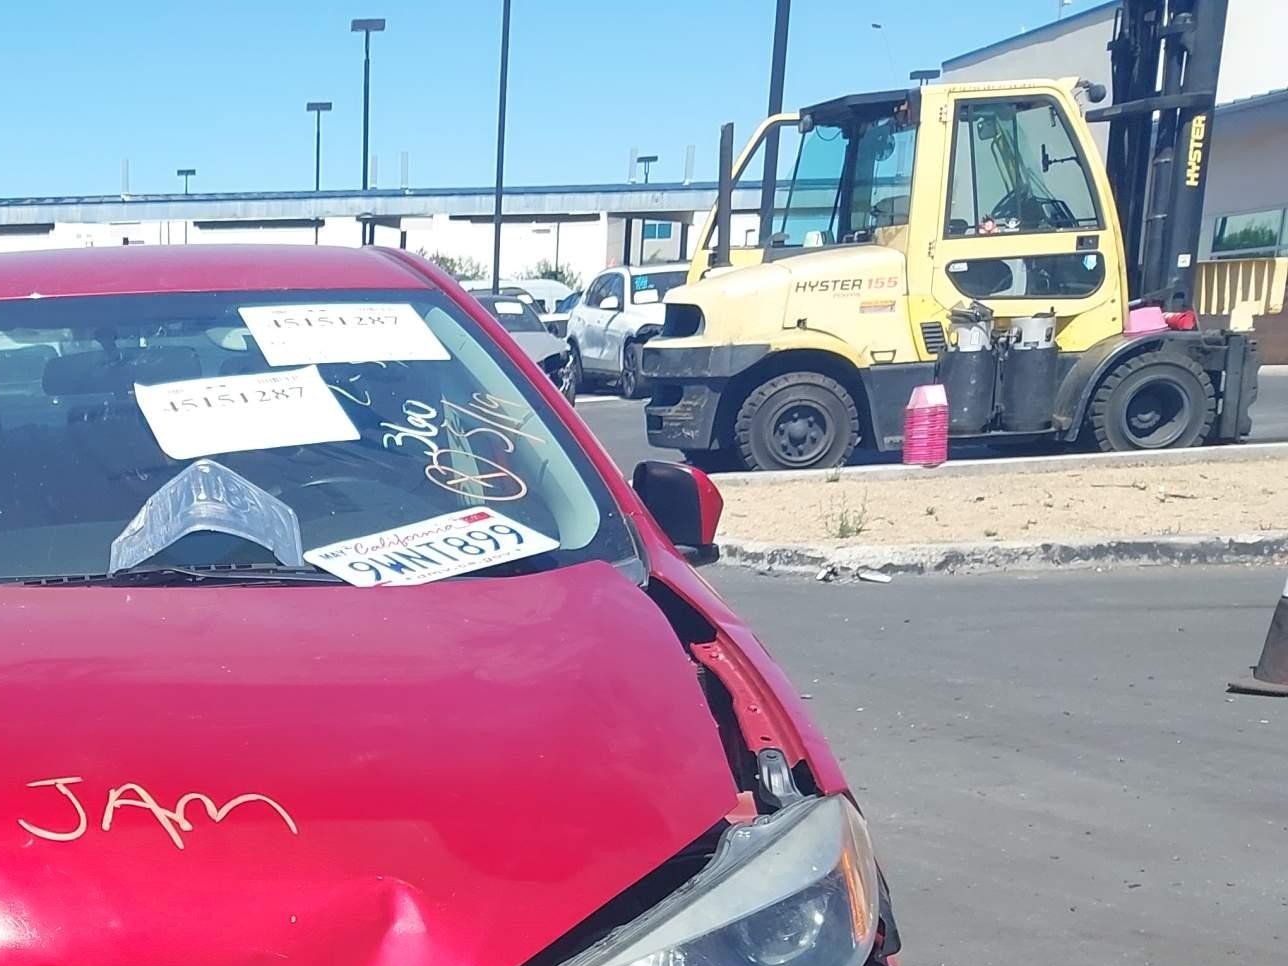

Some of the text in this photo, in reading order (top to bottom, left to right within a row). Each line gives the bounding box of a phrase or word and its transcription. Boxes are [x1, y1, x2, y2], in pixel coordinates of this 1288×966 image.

[1185, 115, 1207, 187] HYSTER
[795, 275, 899, 293] HYSTER 155
[347, 523, 525, 582] 9WNT899
[353, 521, 463, 556] California
